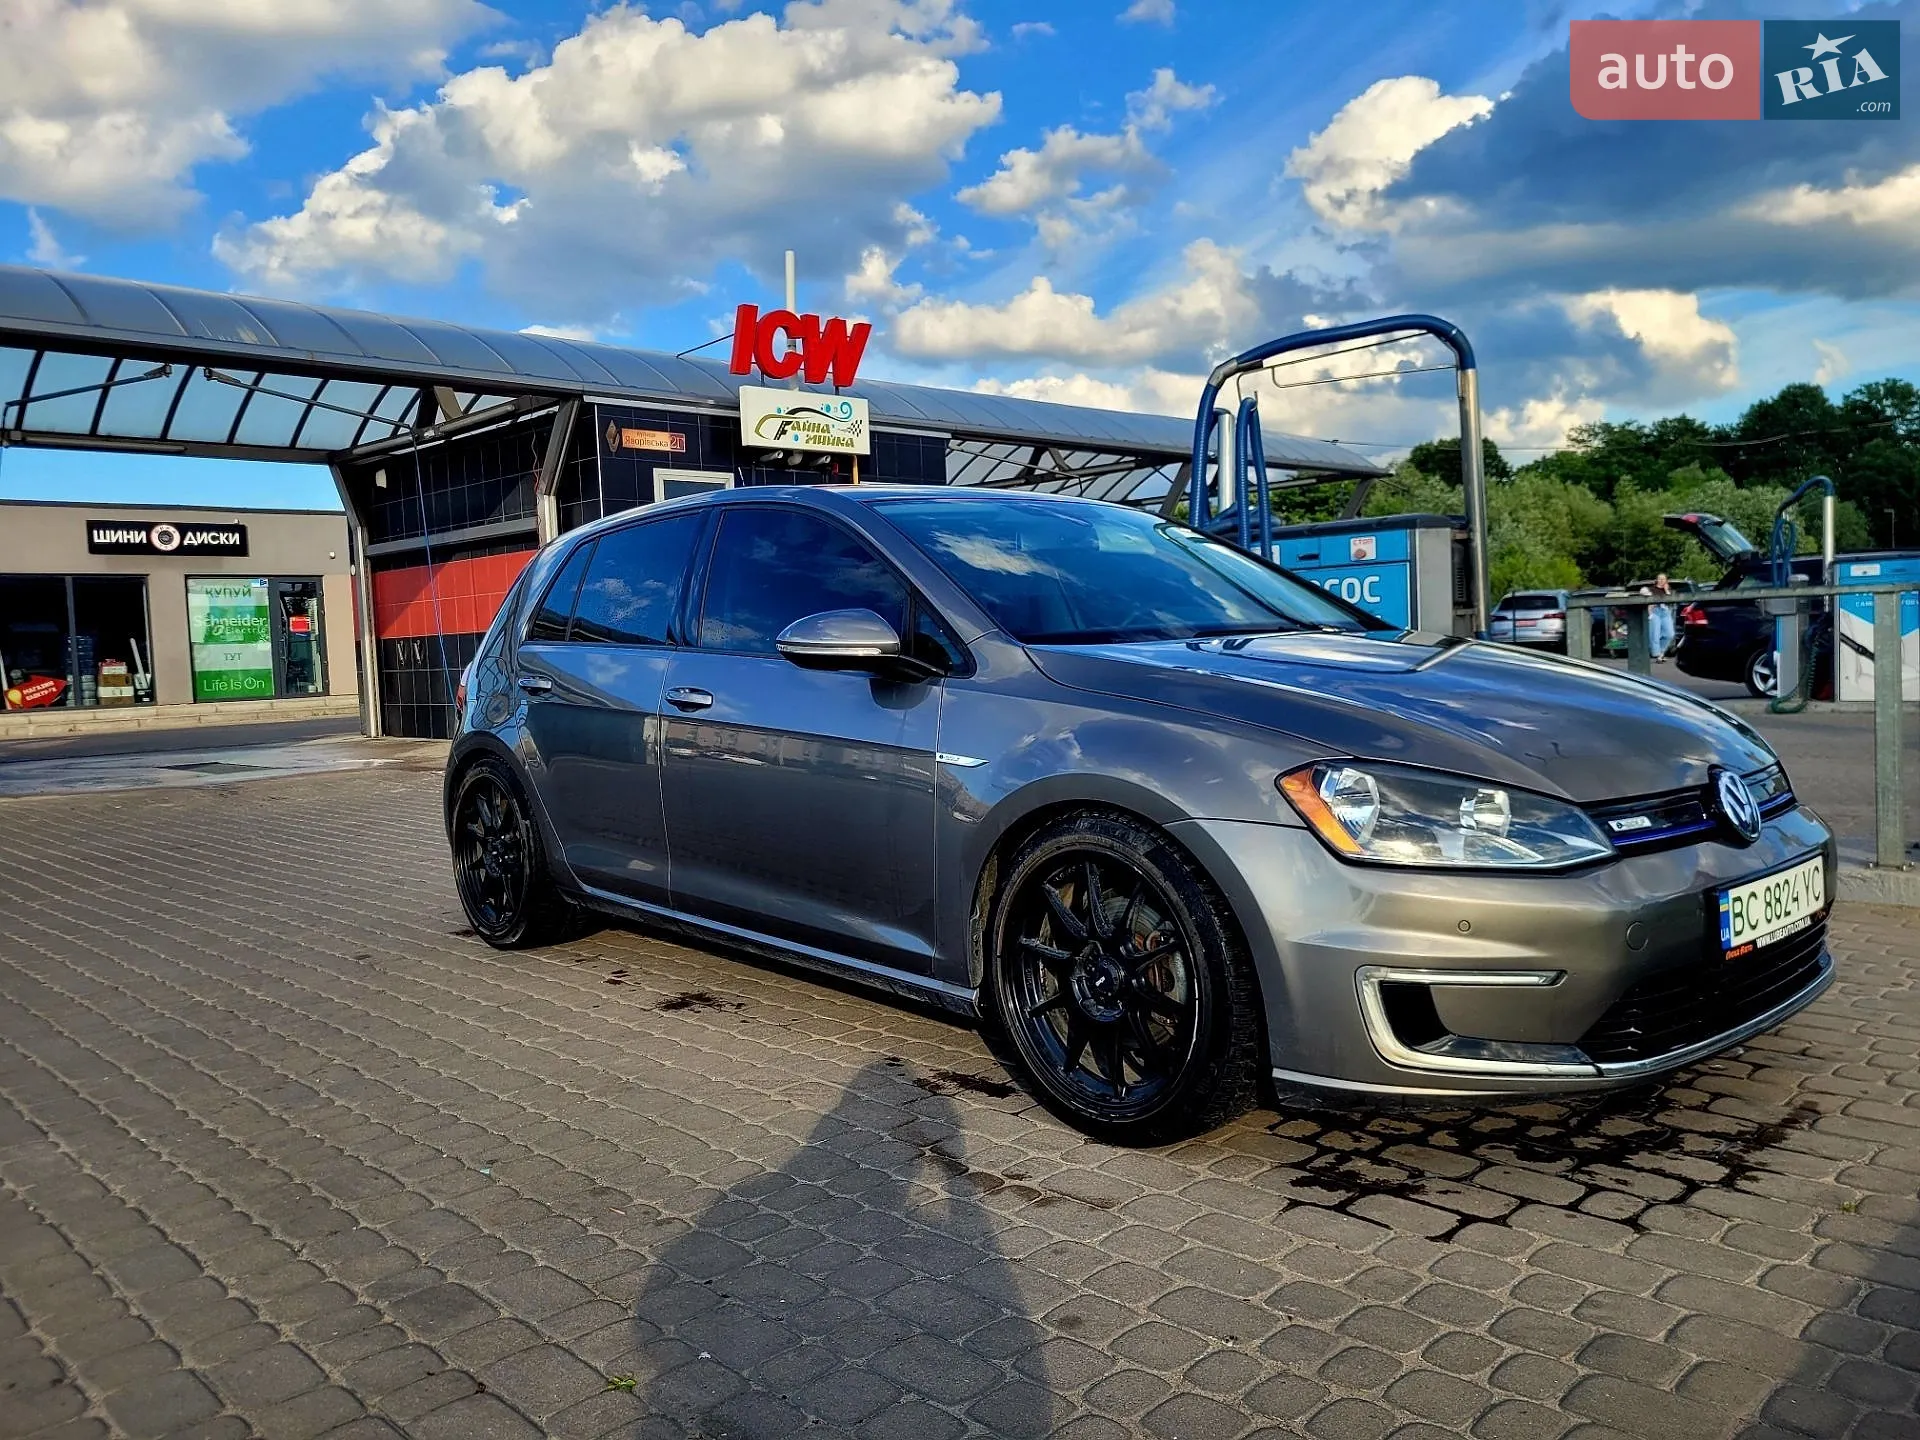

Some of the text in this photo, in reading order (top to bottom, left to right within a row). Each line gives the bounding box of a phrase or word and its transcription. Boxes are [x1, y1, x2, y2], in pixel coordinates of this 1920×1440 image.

[729, 304, 873, 387] ICW
[624, 435, 669, 448] Яворівська
[93, 530, 240, 546] ШИНИ ДИСКИ
[203, 677, 265, 692] Life Is On
[1732, 865, 1821, 937] BC 8824 YC
[1720, 927, 1731, 942] UA
